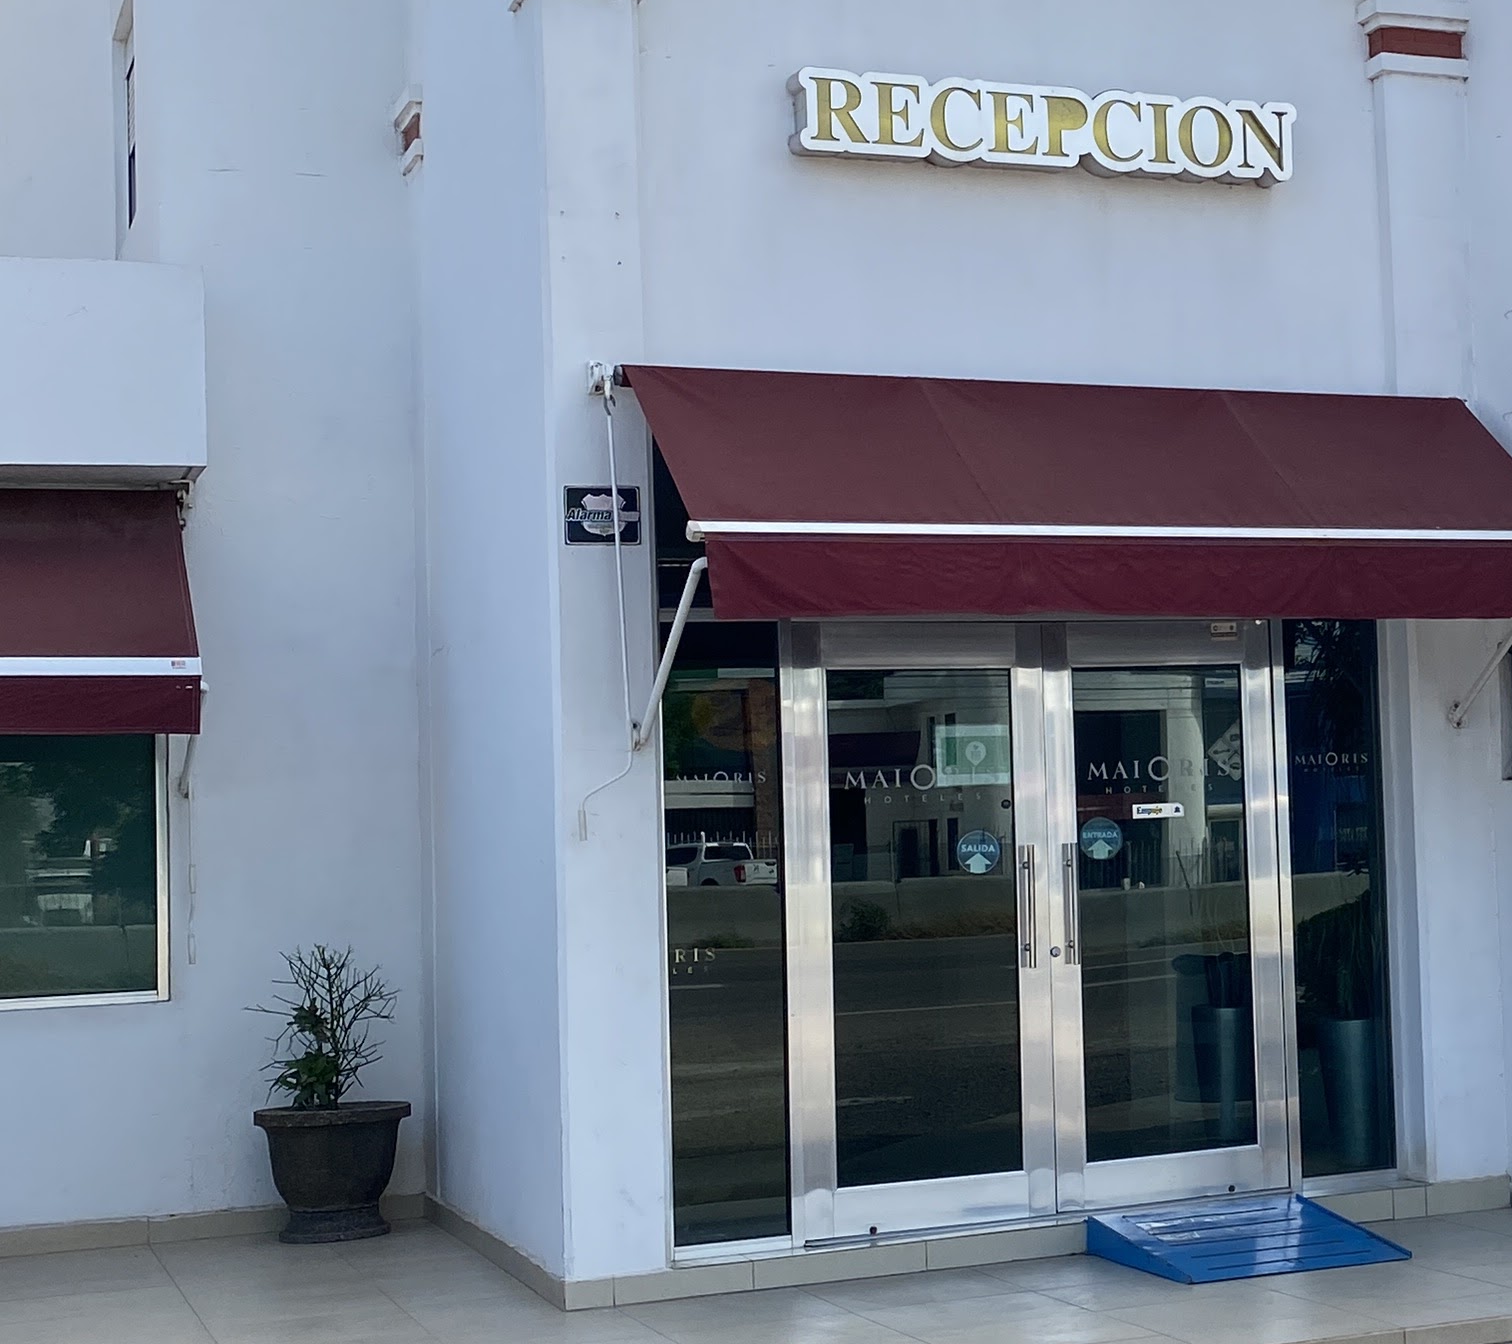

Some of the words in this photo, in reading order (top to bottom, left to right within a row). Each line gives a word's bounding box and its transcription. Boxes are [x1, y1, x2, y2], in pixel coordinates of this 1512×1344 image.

[809, 76, 1288, 172] RECEPCION
[565, 508, 612, 522] Alarma
[1294, 752, 1368, 767] MAIORIS
[1087, 756, 1230, 781] MAIORIS
[864, 792, 981, 806] HOTELES
[1082, 831, 1119, 839] ENTRADA
[961, 844, 996, 853] SALIDA
